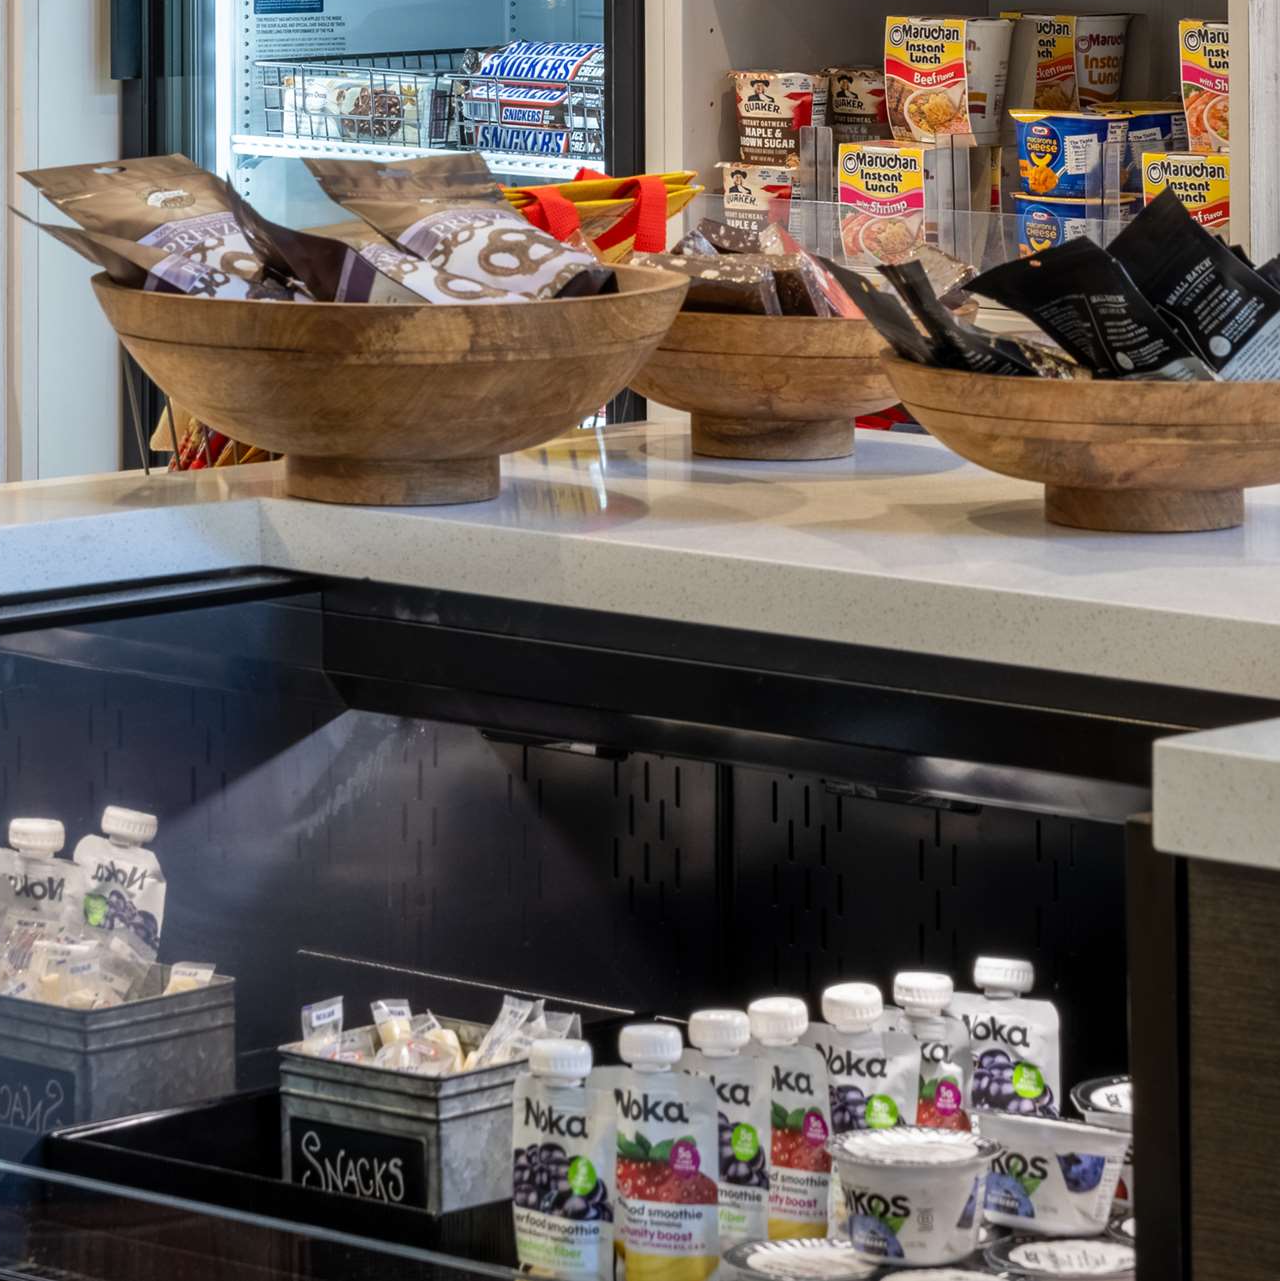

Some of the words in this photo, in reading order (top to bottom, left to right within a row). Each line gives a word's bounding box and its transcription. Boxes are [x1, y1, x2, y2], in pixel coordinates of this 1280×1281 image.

[902, 24, 959, 41] Maruchan
[1197, 29, 1228, 45] Maru
[906, 41, 945, 54] Instant
[909, 52, 941, 64] Lunch
[913, 71, 936, 85] Beef
[937, 71, 955, 82] Flavor
[1199, 77, 1213, 88] with
[503, 108, 542, 122] SNICKERS
[744, 103, 781, 114] QUAKER
[774, 128, 782, 138] &
[764, 138, 795, 148] SUGAR
[856, 152, 917, 170] Maruchan
[861, 169, 902, 182] Instant
[1161, 161, 1225, 178] Maruchan
[865, 181, 899, 193] Lunch
[870, 200, 907, 214] Shrimp
[1203, 210, 1223, 221] Flavor
[1186, 256, 1214, 284] BATCH
[524, 1096, 588, 1139] Noka
[301, 1130, 405, 1204] SNACKS
[990, 1151, 1048, 1180] KOS
[648, 1206, 703, 1219] smoothie
[548, 1222, 600, 1235] smoothie
[657, 1230, 693, 1241] boost
